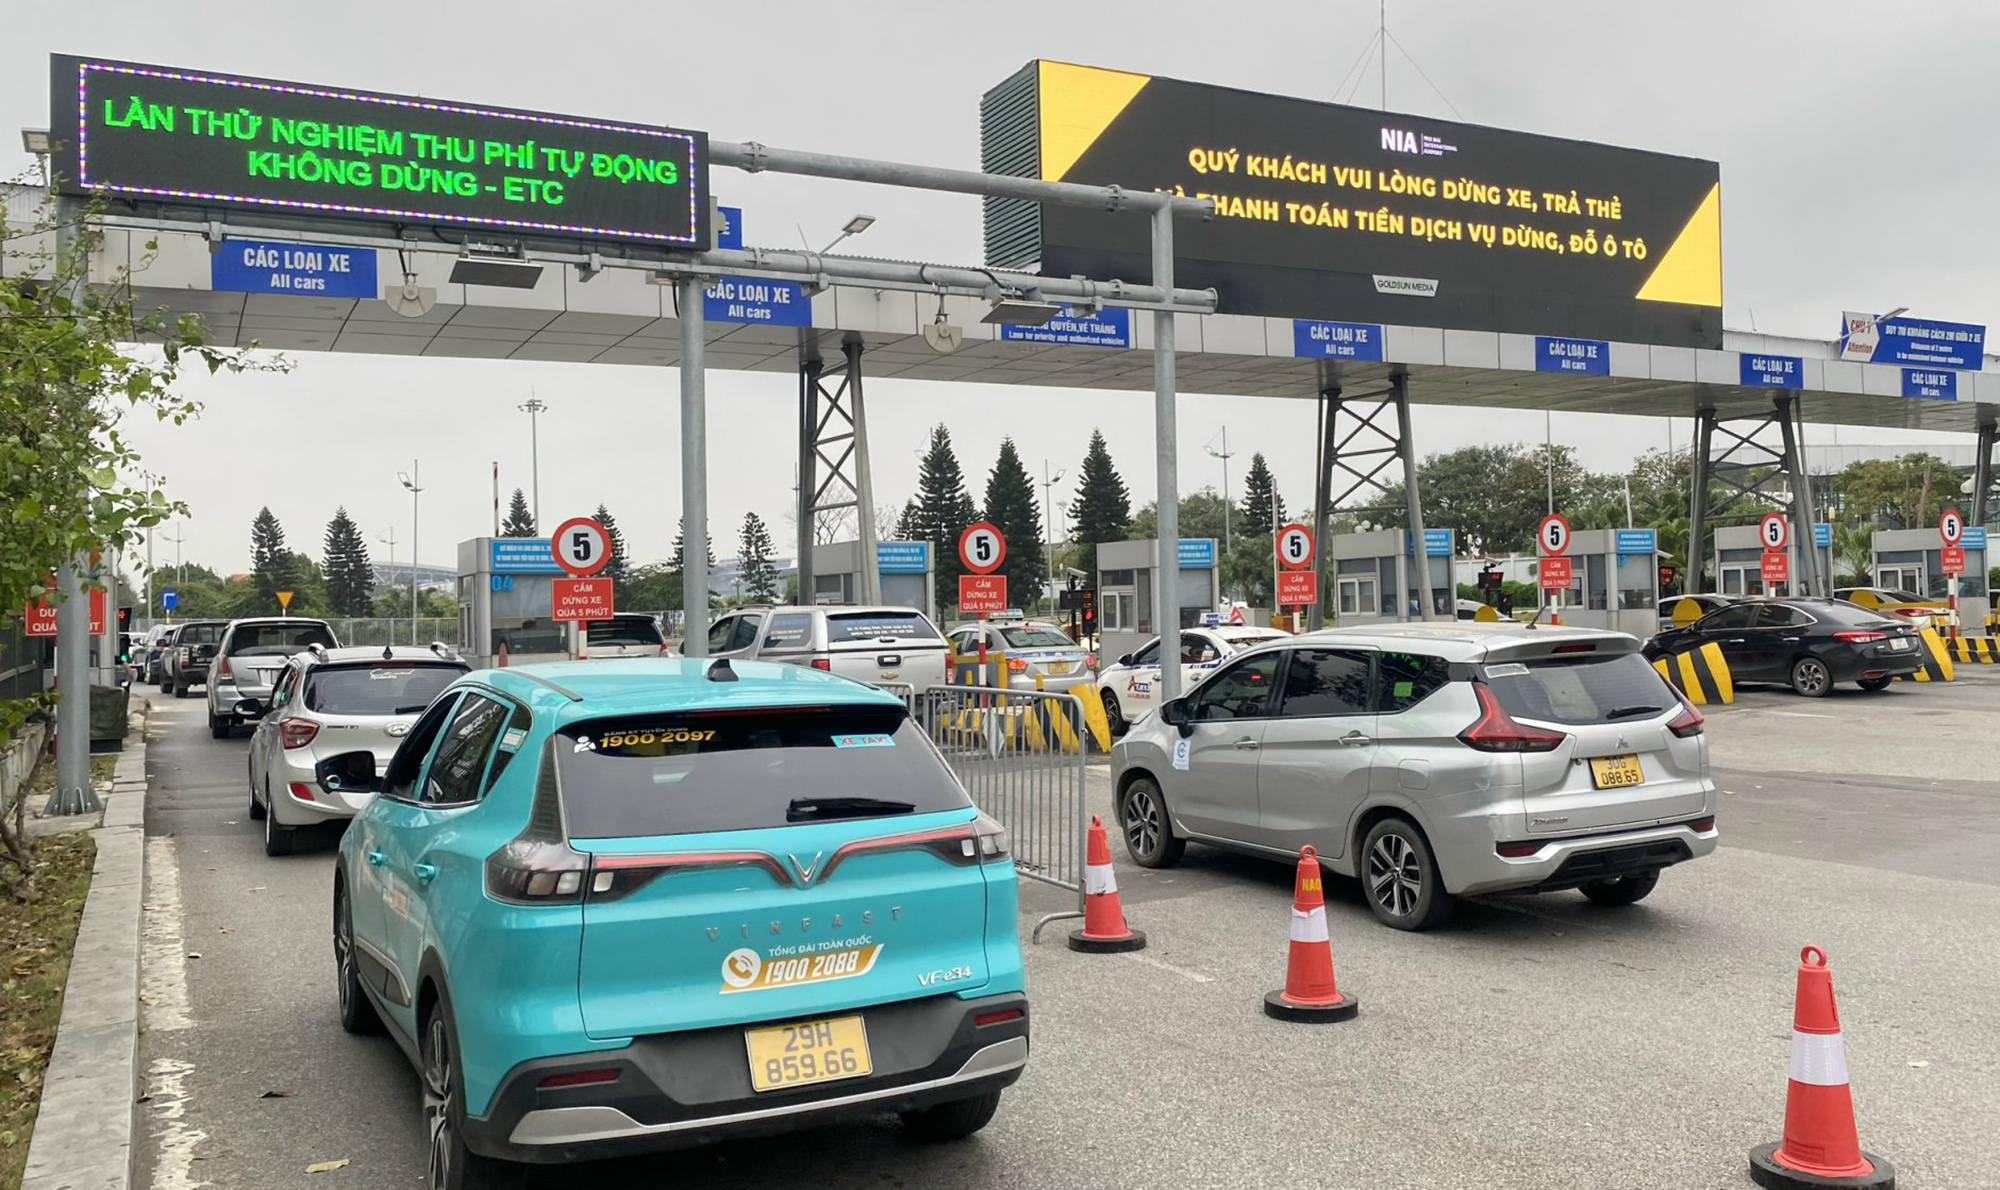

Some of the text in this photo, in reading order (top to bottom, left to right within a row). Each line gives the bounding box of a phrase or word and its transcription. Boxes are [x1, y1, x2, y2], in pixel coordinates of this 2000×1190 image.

[105, 96, 678, 185] LÀN THỬ NGHIỆM THU PHÍ TỰ ĐỘNG
[1381, 128, 1418, 154] NIA
[249, 150, 564, 205] KHÔNG DỪNG - ETC
[1188, 148, 1622, 220] QUÝ KHÁCH VUI LÒNG DỪNG XE, TRẢ THẺ
[1286, 202, 1348, 229] TOÁN
[1354, 206, 1404, 234] TIỀN
[1410, 216, 1462, 242] DỊCH
[1467, 222, 1496, 248] VỤ
[1502, 224, 1564, 255] DỪNG,
[1569, 228, 1598, 255] ĐỖ
[1603, 234, 1618, 257] Ô
[1622, 238, 1647, 260] TÔ
[243, 245, 350, 274] CÁC LOẠI XE
[270, 273, 325, 290] All cars
[1377, 280, 1435, 292] GOLDSUN MEDIA
[706, 279, 791, 305] CÁC LOẠI XE
[728, 304, 772, 320] All cars
[1025, 332, 1034, 340] for
[1034, 332, 1056, 342] priority
[1057, 334, 1068, 342] and
[1090, 322, 1117, 335] THÁNG
[1310, 323, 1368, 344] CÁC LOẠI XE
[1968, 333, 1973, 342] 2
[1325, 344, 1355, 356] All cars
[1549, 340, 1598, 359] CÁC LOẠI XE
[1847, 342, 1873, 353] Attention
[1561, 359, 1587, 370] All cars
[1752, 357, 1794, 374] CÁC LOẠI XE
[1771, 376, 1784, 384] cars
[1911, 372, 1948, 388] CÁC LOẠI XE
[1550, 525, 1560, 546] 5
[1769, 523, 1778, 542] 5
[1947, 519, 1955, 537] 5
[573, 532, 591, 562] 5
[975, 535, 991, 561] 5
[1289, 535, 1302, 558] 5
[1617, 555, 1627, 567] 12
[491, 575, 514, 592] 04
[590, 596, 602, 605] XE
[988, 591, 998, 599] XE
[578, 608, 584, 617] 5
[585, 607, 609, 617] PHÚT
[979, 602, 984, 610] 5
[984, 601, 1004, 610] PHÚT
[32, 620, 58, 632] QUÁ
[599, 730, 716, 748] 1900 2097
[841, 737, 856, 746] XE
[1600, 769, 1640, 786] 088.65
[706, 906, 901, 941] VINFAST
[798, 942, 816, 954] ĐÀI
[817, 939, 844, 951] TOÀN
[845, 934, 872, 948] QUỐC
[764, 950, 860, 984] 1900 2088
[917, 965, 973, 986] VF e34
[782, 1021, 834, 1053] 29H
[765, 1047, 858, 1085] 859.66
